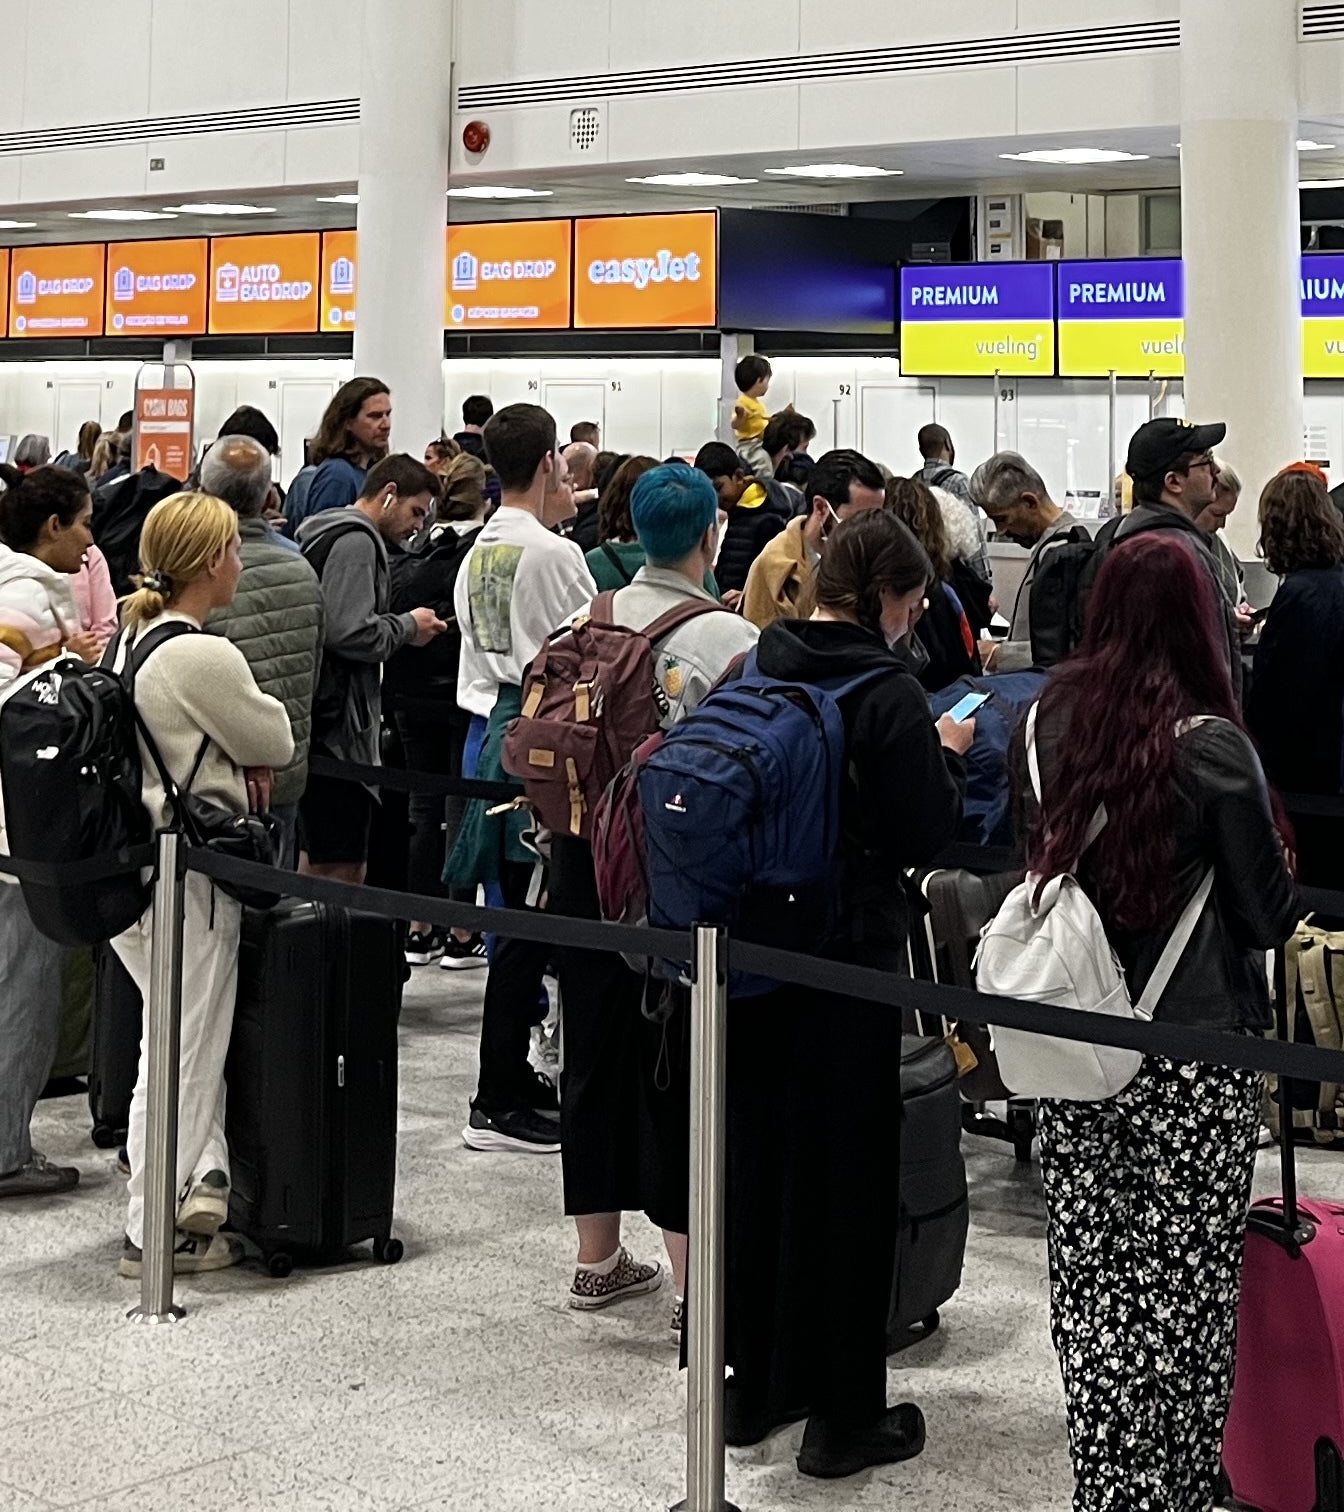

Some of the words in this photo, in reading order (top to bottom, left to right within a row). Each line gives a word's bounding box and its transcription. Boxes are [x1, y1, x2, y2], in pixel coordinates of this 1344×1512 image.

[241, 265, 281, 283] AUTO
[481, 262, 512, 280] BAG
[514, 260, 556, 279] DROP
[589, 250, 701, 288] easyJet
[38, 280, 61, 295] BAG
[63, 277, 94, 293] DROP
[137, 276, 161, 292] BAG
[162, 273, 196, 290] DROP
[240, 284, 270, 301] BAG
[271, 282, 312, 300] DROP
[911, 285, 999, 306] PREMIUM
[1069, 282, 1166, 304] PREMIUM
[976, 334, 1038, 361] vueling
[839, 384, 851, 395] 92
[1001, 389, 1014, 401] 93
[143, 399, 166, 417] CABIN
[167, 399, 188, 417] BAGS
